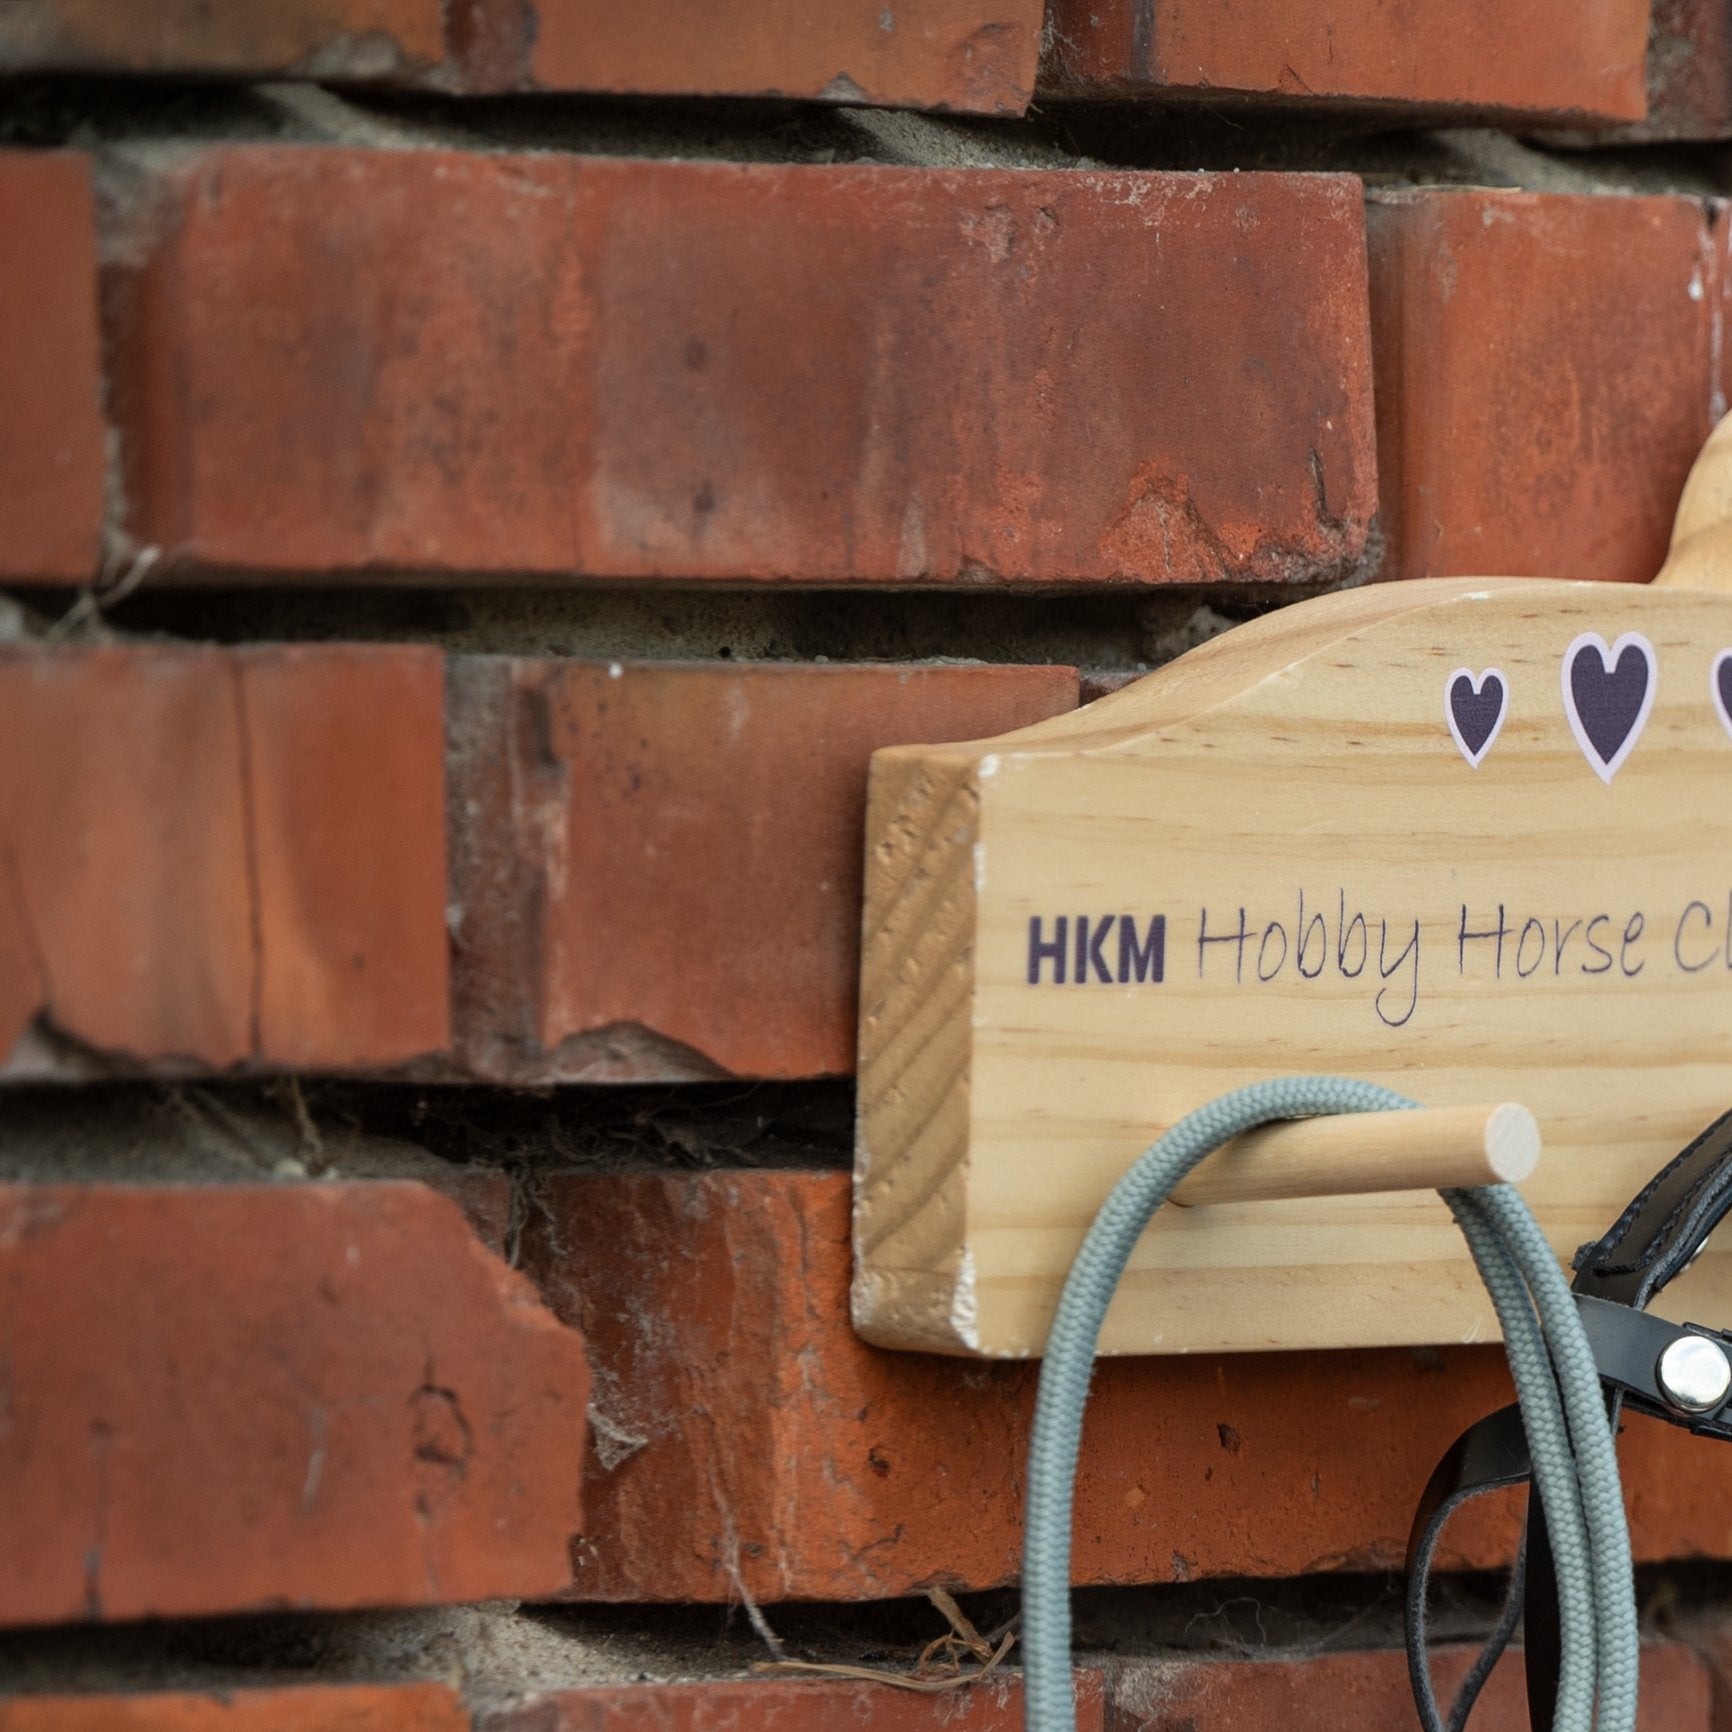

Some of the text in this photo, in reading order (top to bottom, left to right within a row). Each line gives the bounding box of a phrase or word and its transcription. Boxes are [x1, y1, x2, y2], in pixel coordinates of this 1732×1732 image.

[1027, 914, 1167, 985] HKM
[1198, 887, 1419, 1027] Hobby
[1458, 902, 1646, 978] Horse
